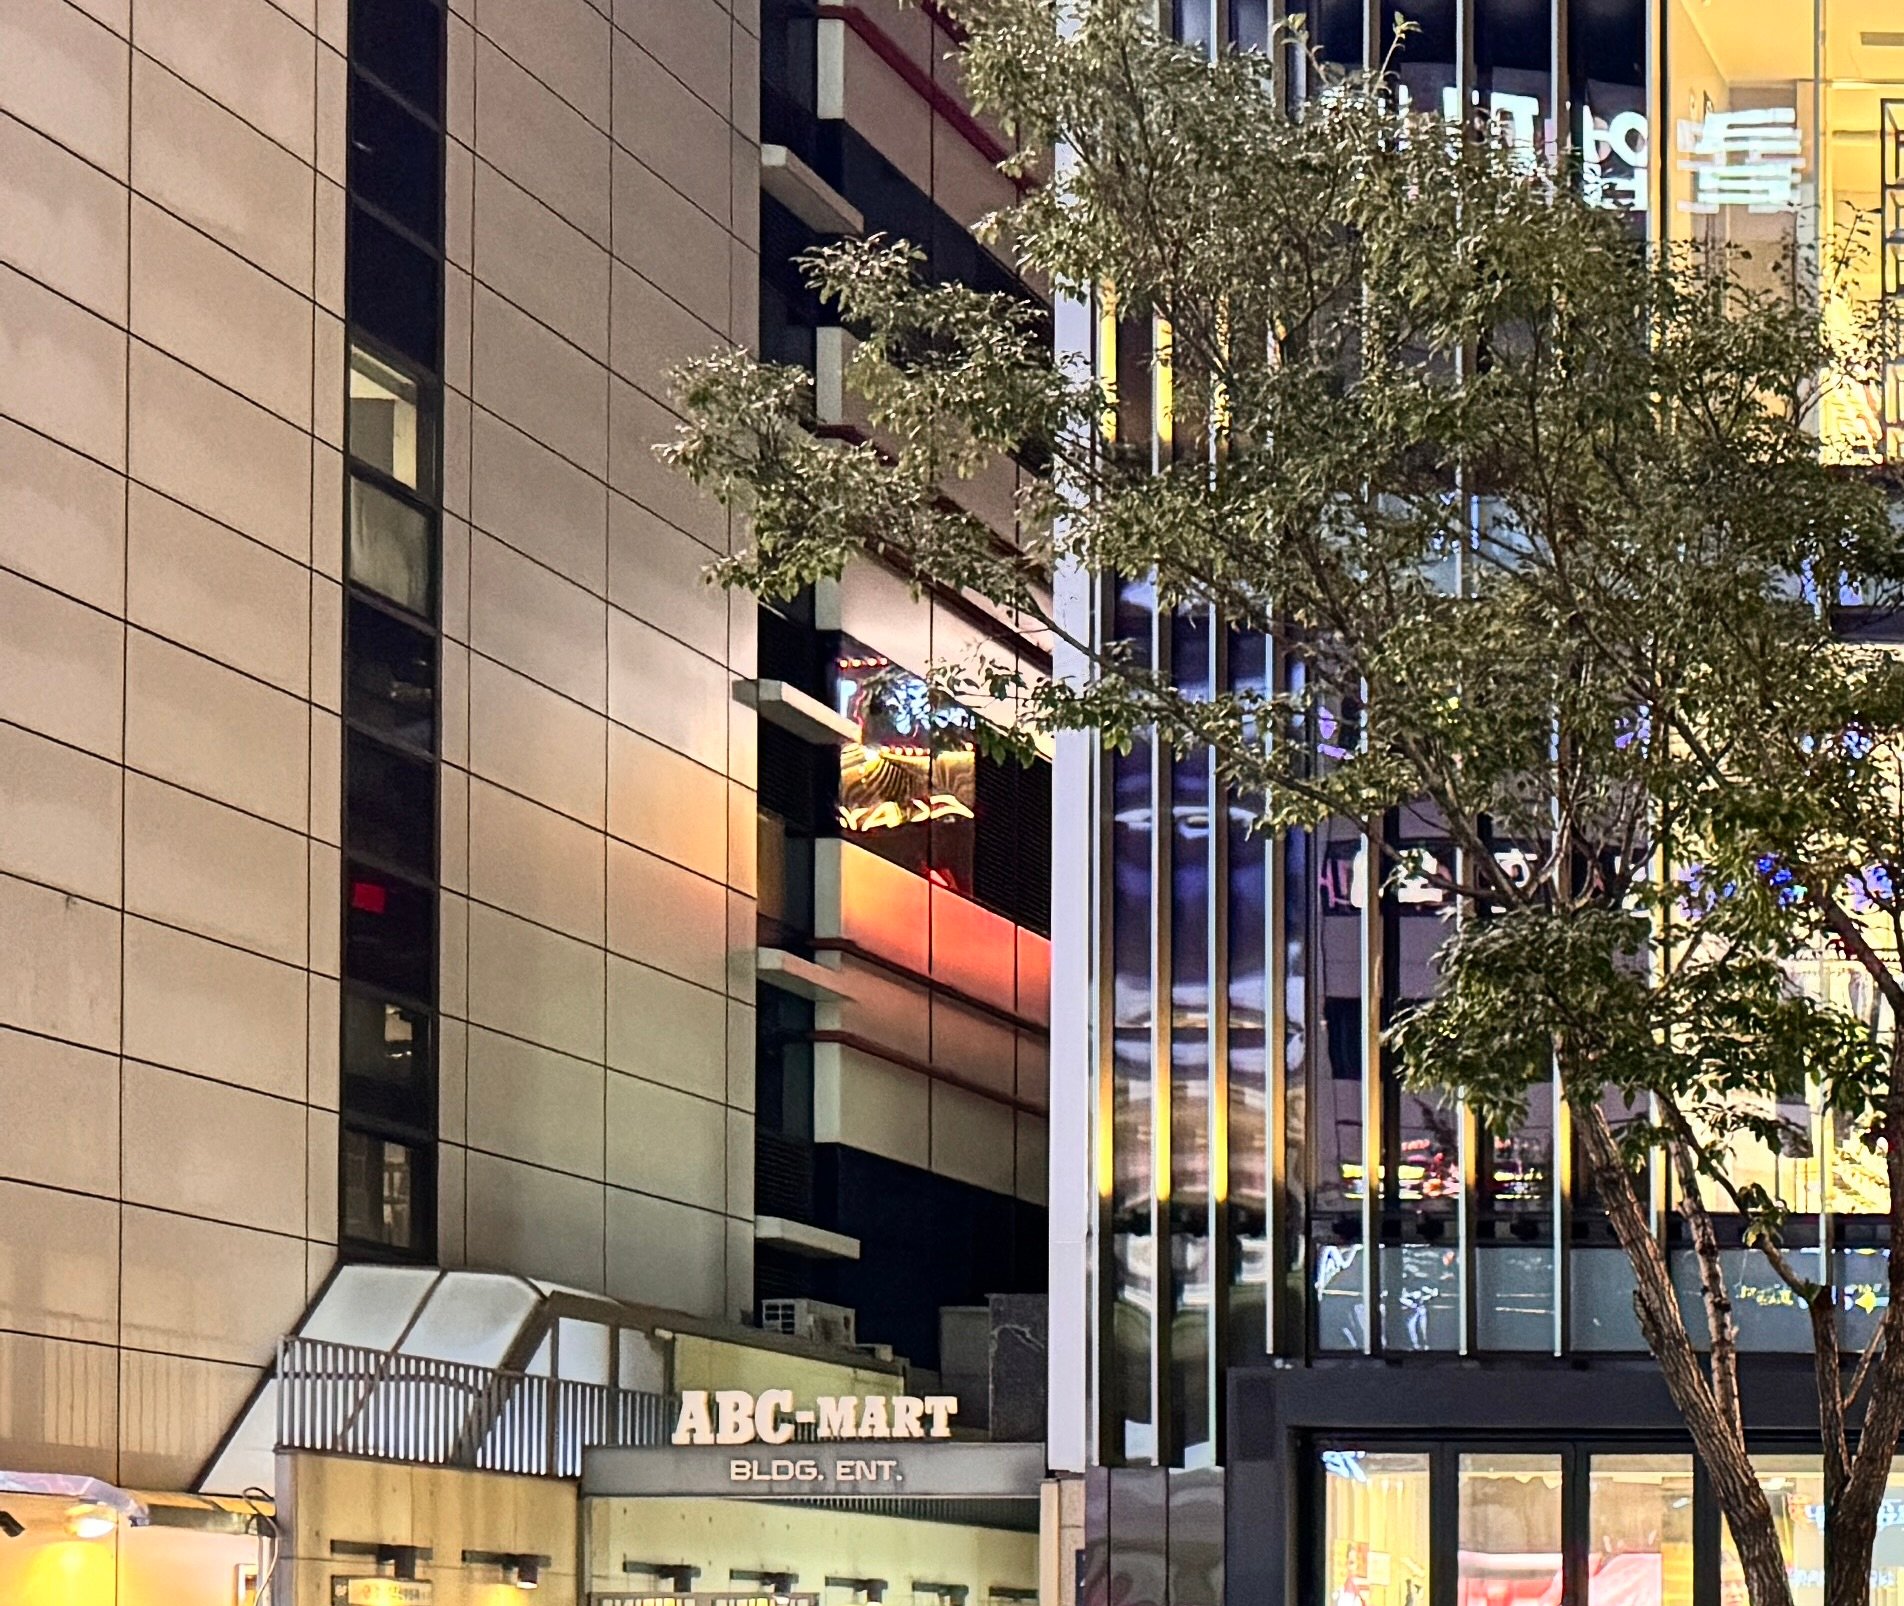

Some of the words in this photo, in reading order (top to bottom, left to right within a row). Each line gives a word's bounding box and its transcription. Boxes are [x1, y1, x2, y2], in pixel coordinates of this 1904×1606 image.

[671, 1389, 958, 1446] ABC-MART
[729, 1459, 827, 1484] BLDG.
[835, 1459, 904, 1483] ENT.
